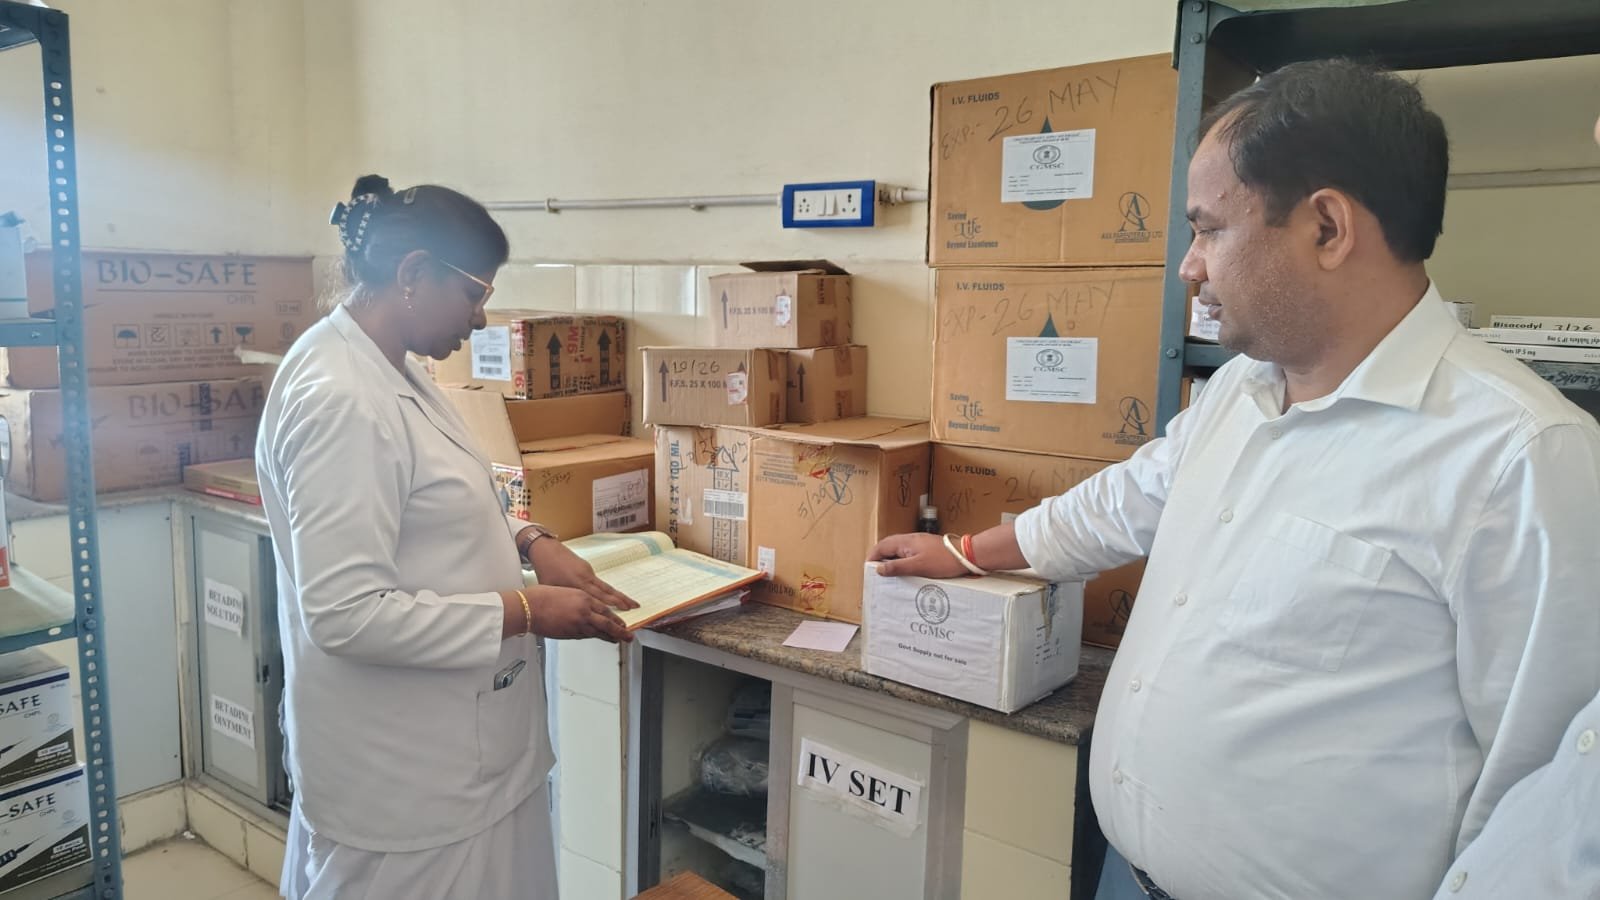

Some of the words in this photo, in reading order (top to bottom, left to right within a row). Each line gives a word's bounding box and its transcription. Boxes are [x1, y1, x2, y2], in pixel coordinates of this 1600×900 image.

[951, 96, 965, 105] I.V.
[967, 92, 1000, 103] FLUIDS
[987, 95, 1033, 141] 26
[1049, 69, 1121, 113] MAY
[953, 216, 982, 240] Life
[97, 258, 257, 286] BIO-SAFE
[956, 282, 970, 291] I.V.
[972, 282, 1005, 291] FLUIDS
[991, 292, 1034, 336] 26
[1493, 321, 1543, 330] Bisacodyl
[708, 380, 721, 388] 100
[670, 440, 680, 457] ML
[964, 466, 997, 476] FLUIDS
[910, 621, 955, 641] CGMSC
[898, 642, 912, 651] Govt
[913, 647, 932, 657] Supply
[808, 752, 841, 784] IV
[848, 769, 911, 815] SET
